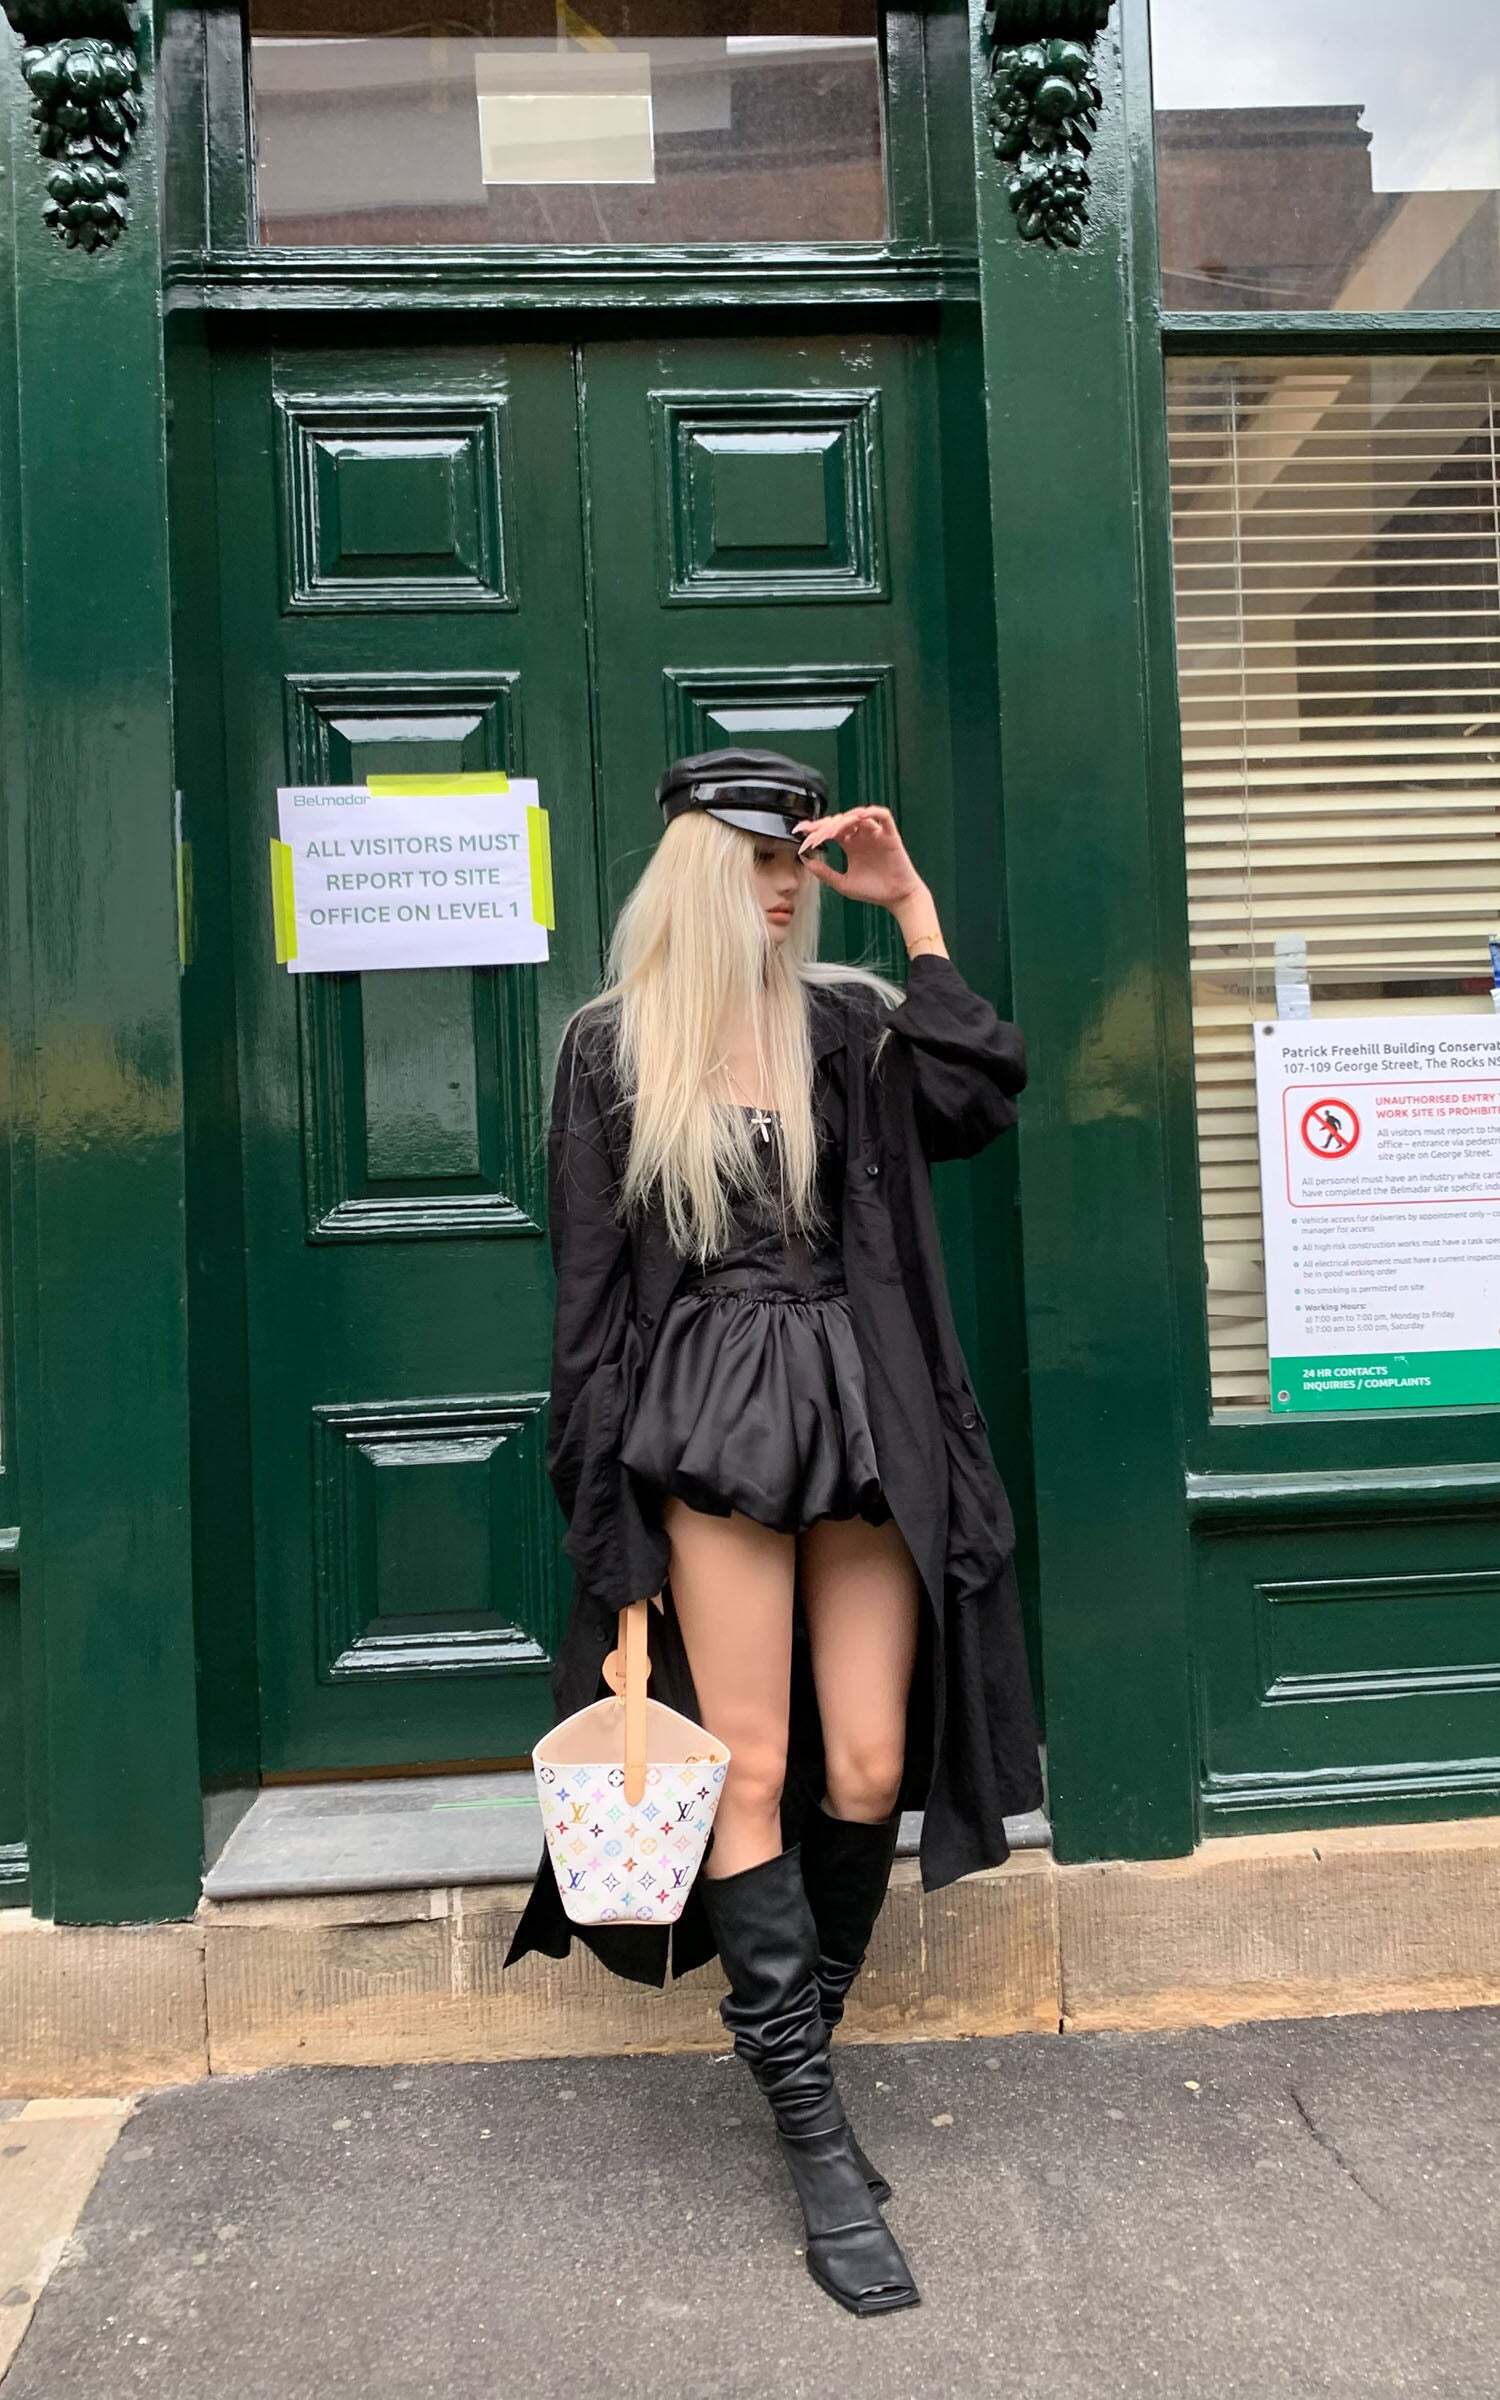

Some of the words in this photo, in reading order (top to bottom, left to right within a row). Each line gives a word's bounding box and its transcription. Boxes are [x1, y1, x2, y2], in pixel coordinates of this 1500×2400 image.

[294, 794, 371, 807] Belmadar
[306, 840, 346, 859] ALL
[350, 837, 453, 856] VISITORS
[459, 834, 520, 853] MUST
[326, 871, 414, 892] REPORT
[419, 870, 448, 888] TO
[455, 868, 500, 887] SITE
[310, 905, 390, 926] OFFICE
[397, 904, 430, 923] ON
[438, 902, 503, 921] LEVEL
[509, 902, 519, 918] 1
[1282, 1045, 1328, 1058] Patrick
[1332, 1043, 1380, 1056] Freehill
[1383, 1042, 1435, 1055] Building
[1284, 1062, 1331, 1073] 107-109
[1335, 1061, 1378, 1074] George
[1381, 1059, 1423, 1071] Street,
[1426, 1057, 1447, 1069] The
[1450, 1057, 1485, 1068] Rocks
[1375, 1094, 1459, 1106] UNAUTHORISED
[1462, 1093, 1495, 1103] ENTRY
[1376, 1109, 1409, 1119] WORK
[1411, 1108, 1434, 1118] SITE
[1437, 1108, 1446, 1117] IS
[1377, 1128, 1389, 1137] All
[1390, 1127, 1421, 1137] visitors
[1423, 1127, 1446, 1136] must
[1447, 1126, 1474, 1137] report
[1476, 1126, 1486, 1134] to
[1377, 1140, 1403, 1149] office
[1412, 1139, 1450, 1148] entrance
[1452, 1139, 1464, 1147] via
[1378, 1153, 1395, 1161] site
[1396, 1152, 1416, 1162] gate
[1430, 1150, 1462, 1161] George
[1302, 1177, 1314, 1186] All
[1315, 1176, 1359, 1187] personnel
[1361, 1175, 1383, 1184] must
[1385, 1174, 1405, 1183] have
[1420, 1173, 1455, 1183] industry
[1457, 1171, 1481, 1180] white
[1302, 1189, 1323, 1197] have
[1325, 1187, 1372, 1198] completed
[1373, 1186, 1388, 1195] the
[1434, 1184, 1449, 1193] site
[1451, 1183, 1483, 1194] specific
[1408, 1213, 1417, 1222] by
[1303, 1287, 1316, 1295] No
[1410, 1283, 1425, 1291] site
[1304, 1303, 1339, 1312] Working
[1340, 1302, 1367, 1311] Hours:
[1390, 1311, 1421, 1321] Monday
[1432, 1310, 1455, 1320] Friday
[1391, 1321, 1425, 1331] Saturday
[1302, 1369, 1316, 1378] 24
[1316, 1368, 1332, 1377] HR
[1333, 1366, 1388, 1377] CONTACTS
[1303, 1380, 1356, 1392] INQUIRIES
[1364, 1377, 1431, 1388] COMPLAINTS
